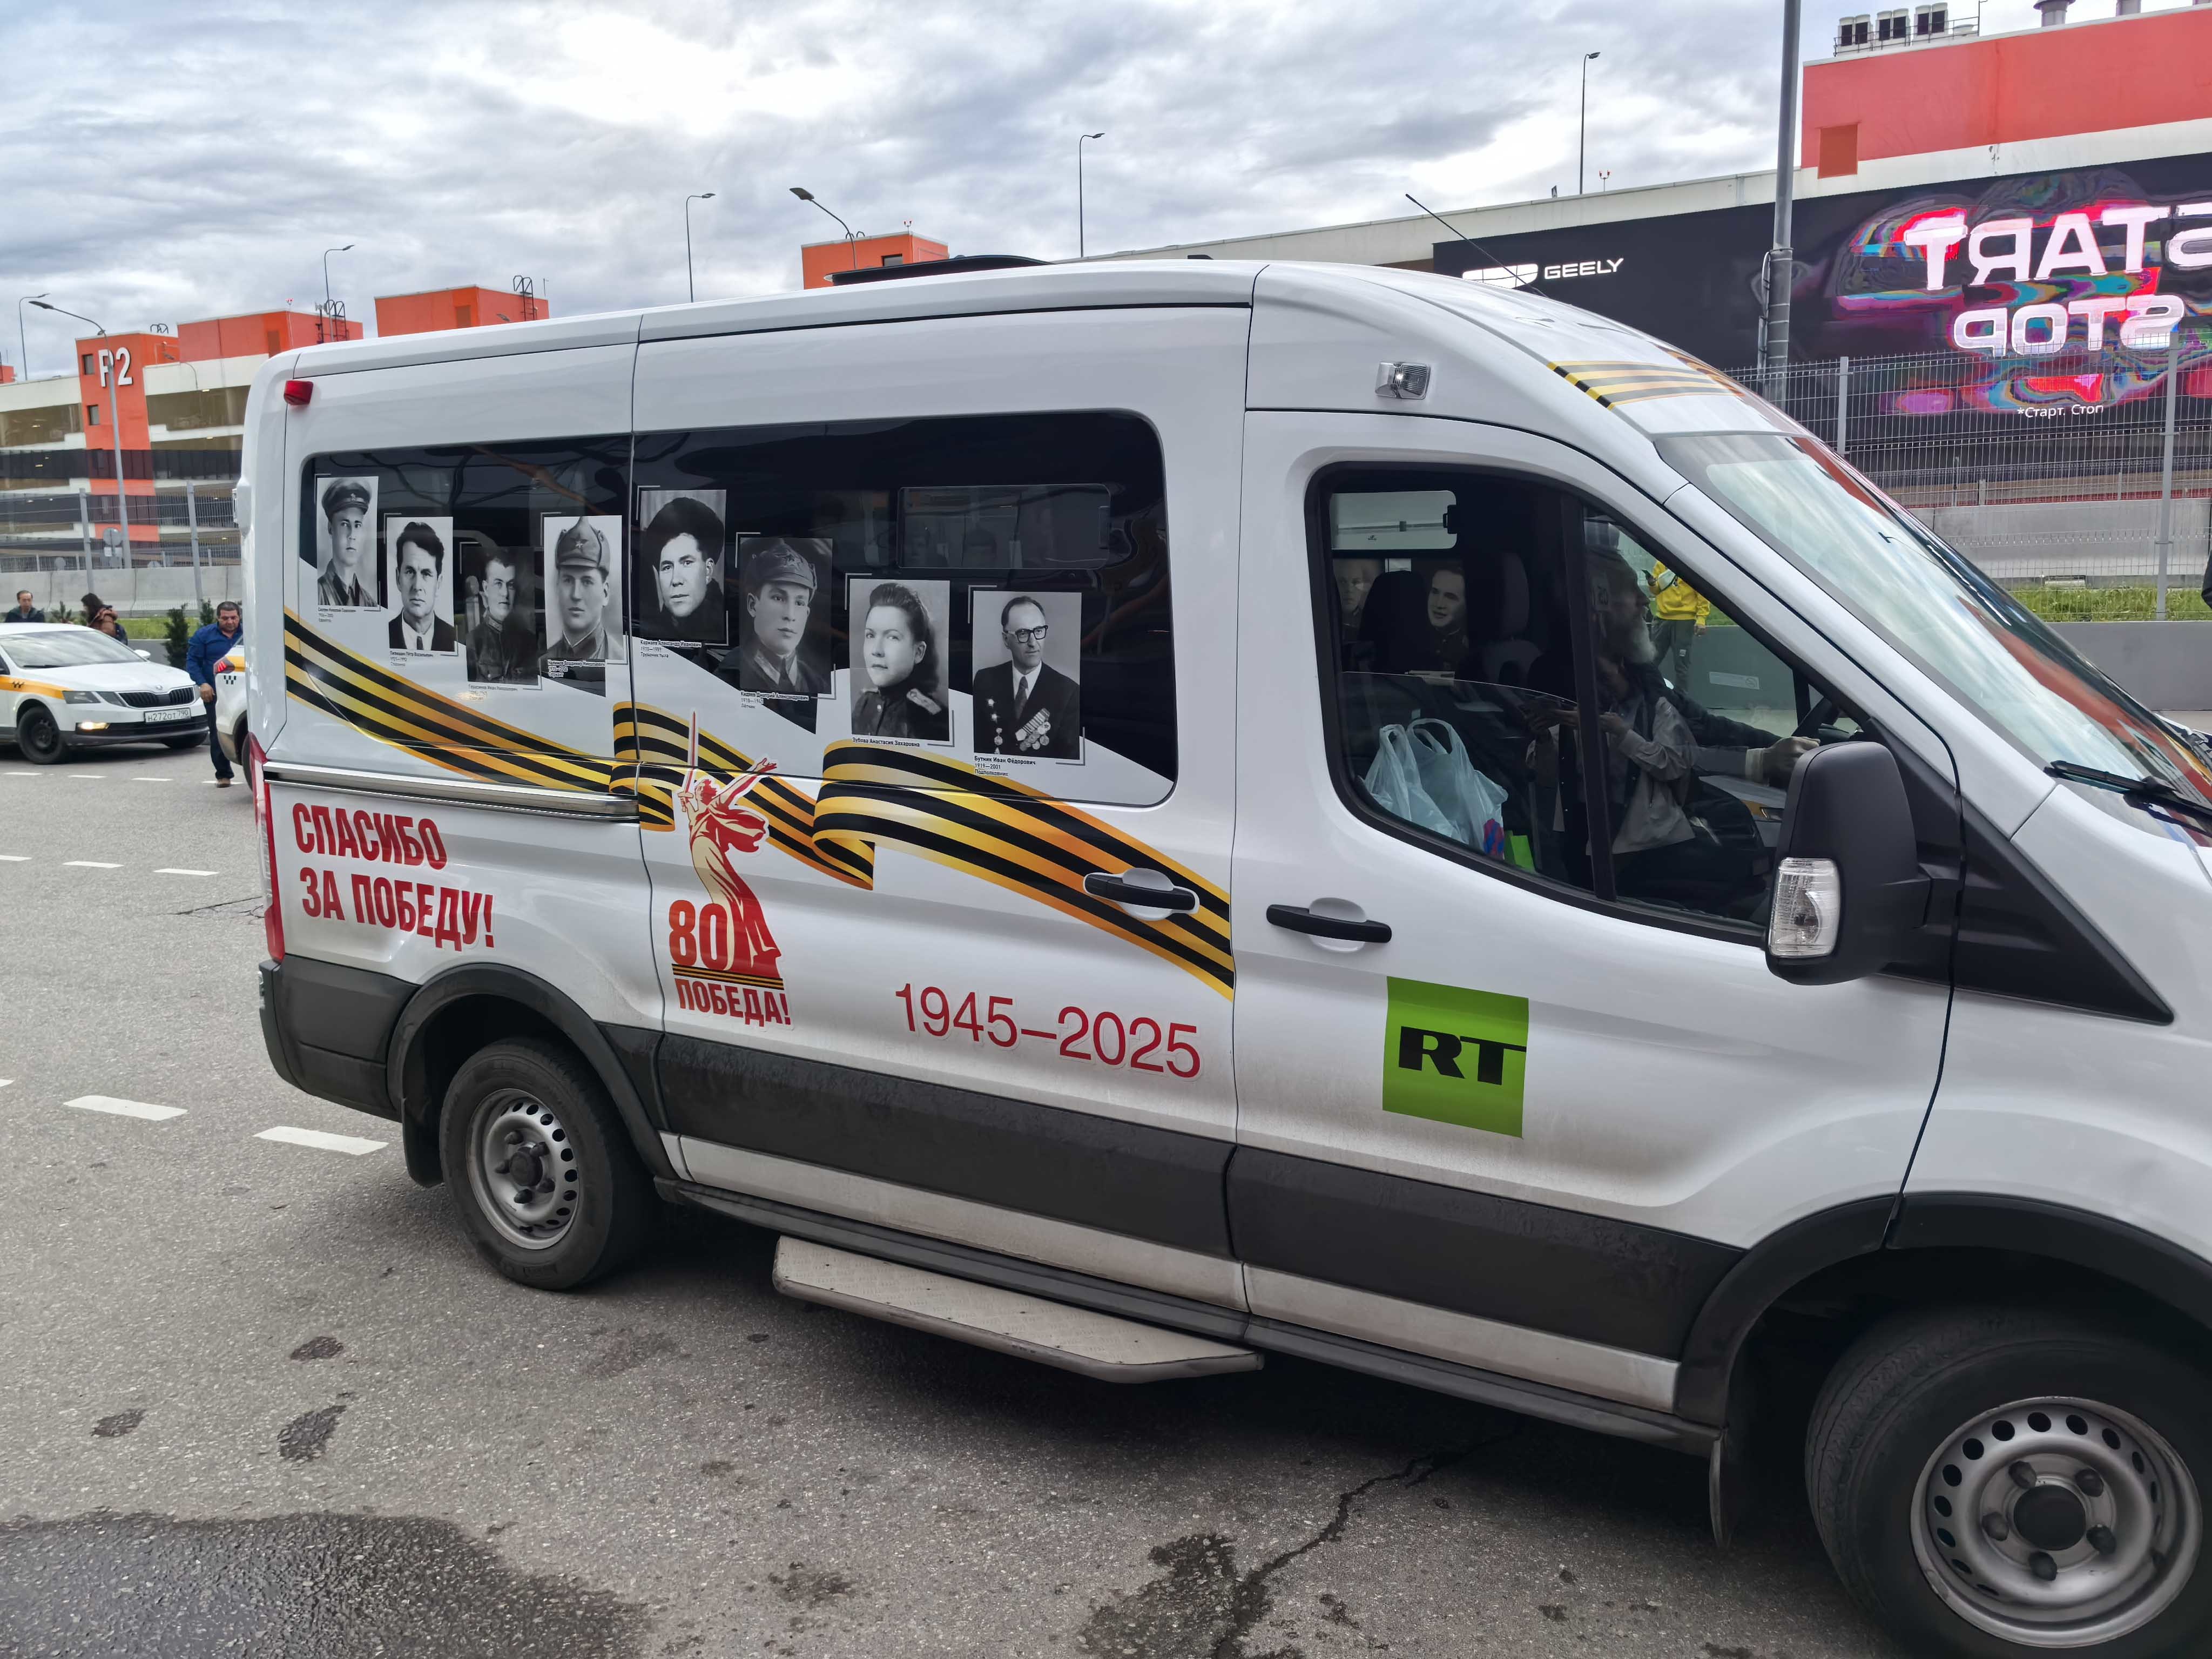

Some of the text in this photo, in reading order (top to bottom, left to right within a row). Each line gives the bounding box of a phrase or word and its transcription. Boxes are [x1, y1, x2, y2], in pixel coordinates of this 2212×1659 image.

[1544, 258, 1624, 280] GEELY
[98, 347, 133, 388] P2
[2071, 404, 2104, 415] Стоп
[292, 802, 448, 870] СПАСИБО
[300, 867, 495, 952] ЗА ПОБЕДУ!
[669, 900, 729, 970] 80
[674, 978, 791, 1027] ПОБЕДА!
[1398, 1026, 1527, 1085] RT
